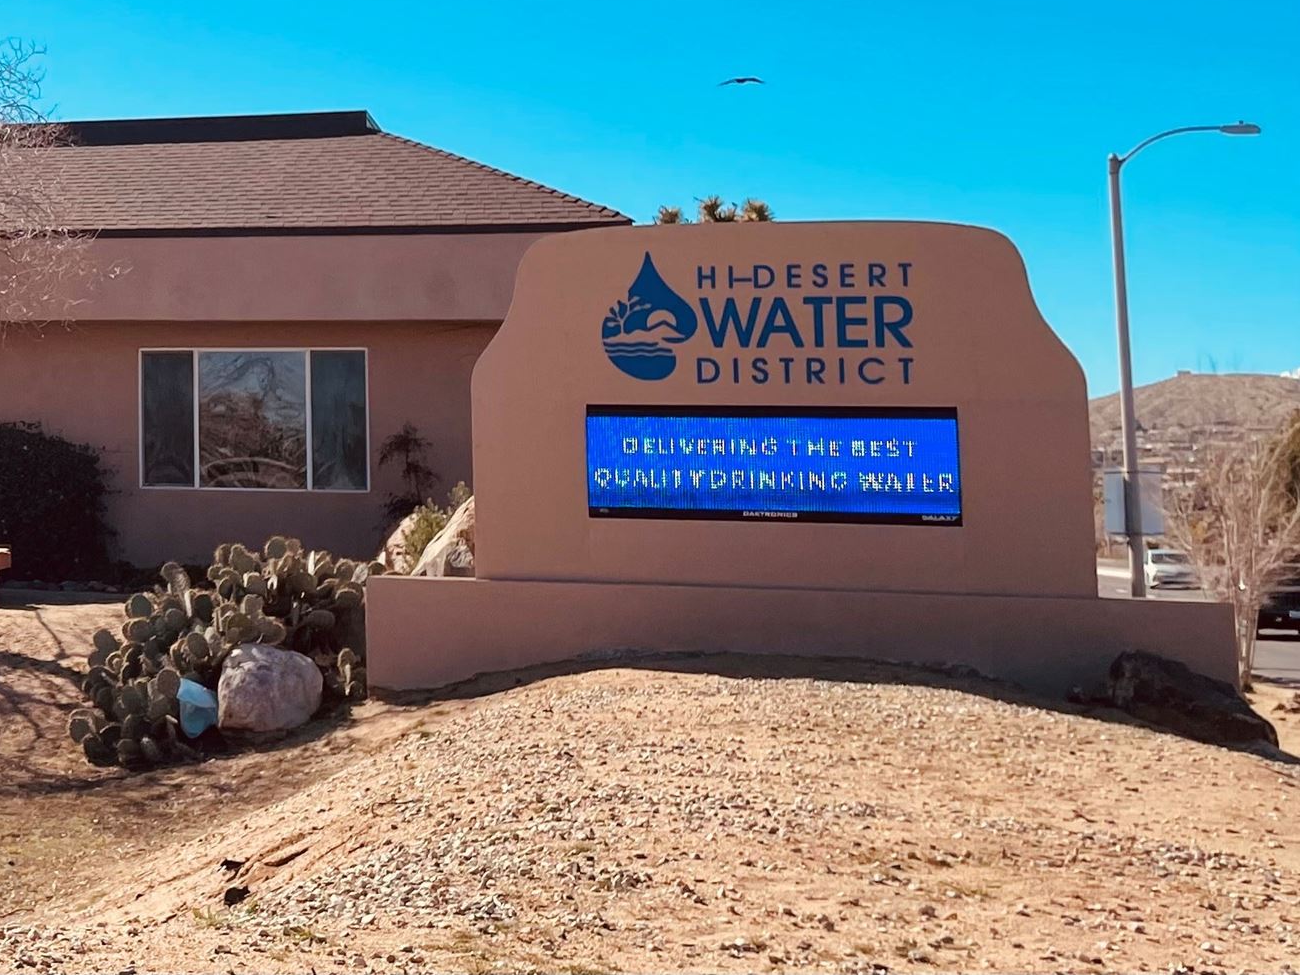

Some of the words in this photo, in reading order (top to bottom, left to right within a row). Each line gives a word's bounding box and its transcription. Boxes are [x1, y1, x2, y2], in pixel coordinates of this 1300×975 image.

[697, 263, 913, 289] HI-DESERT
[698, 296, 913, 348] WATER
[697, 357, 913, 384] DISTRICT
[622, 437, 778, 456] DELIVERING
[786, 437, 842, 457] THE
[851, 438, 918, 457] BEST
[859, 471, 954, 492] WATER
